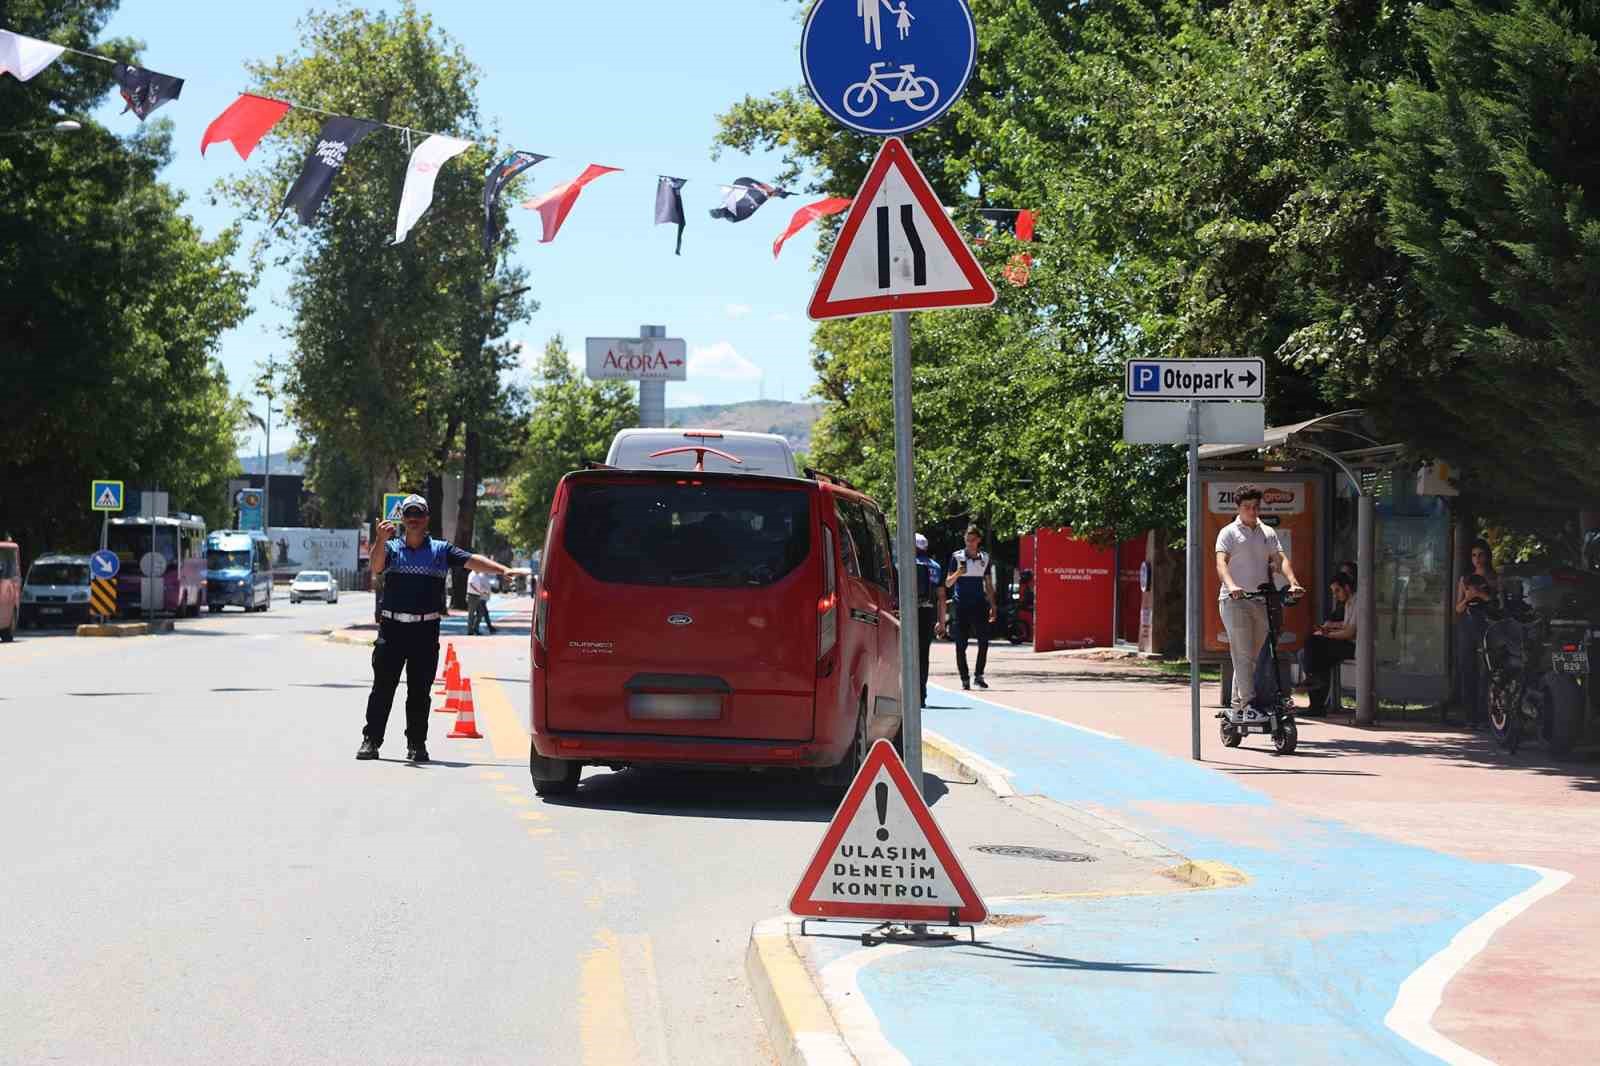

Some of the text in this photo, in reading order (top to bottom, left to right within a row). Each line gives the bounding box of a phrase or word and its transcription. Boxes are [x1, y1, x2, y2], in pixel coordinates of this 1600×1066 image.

[603, 349, 668, 371] AGORA
[1139, 368, 1234, 393] P Otopark
[841, 845, 927, 861] ULAŞIM
[833, 863, 935, 880] DENETİM
[832, 882, 938, 899] KONTROL
